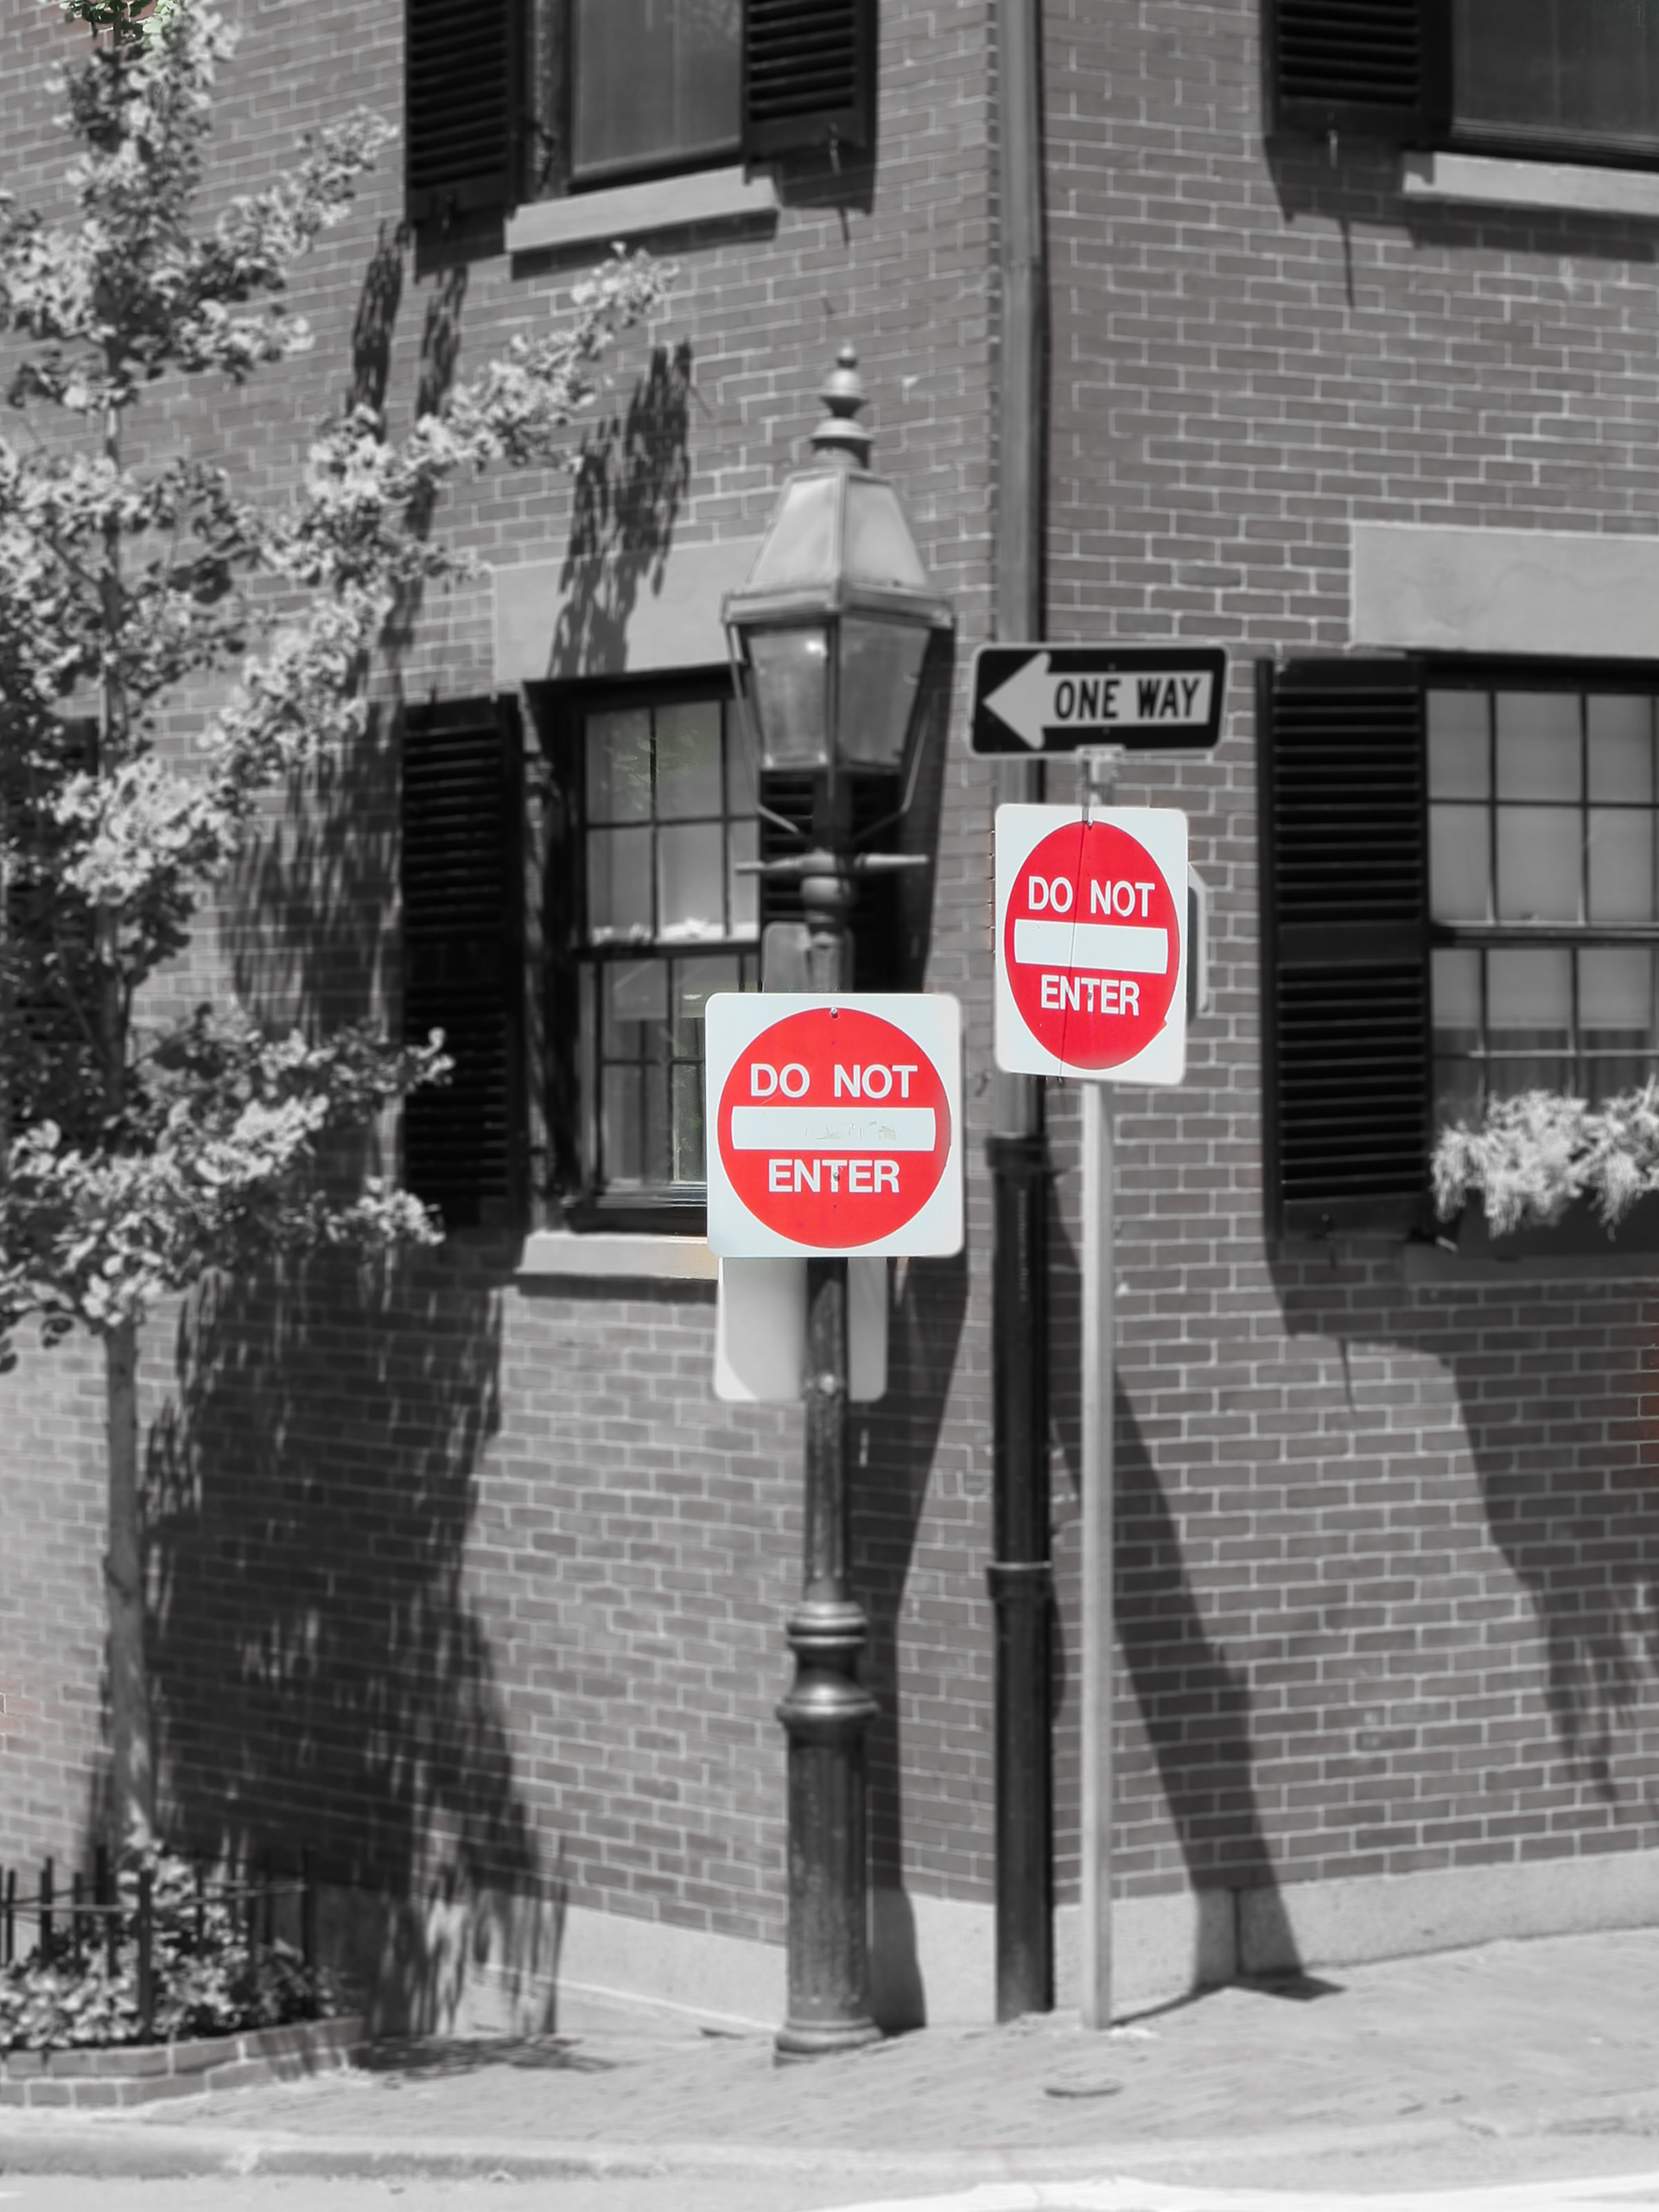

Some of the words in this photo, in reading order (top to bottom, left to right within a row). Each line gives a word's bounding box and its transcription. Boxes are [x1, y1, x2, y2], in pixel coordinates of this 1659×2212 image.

[1054, 678, 1121, 721] ONE
[1136, 677, 1200, 719] WAY
[1029, 876, 1073, 912] DO
[1090, 880, 1155, 917] NOT
[1040, 975, 1140, 1016] ENTER
[751, 1063, 810, 1098] DO
[834, 1064, 918, 1098] NOT
[769, 1159, 899, 1192] ENTER
